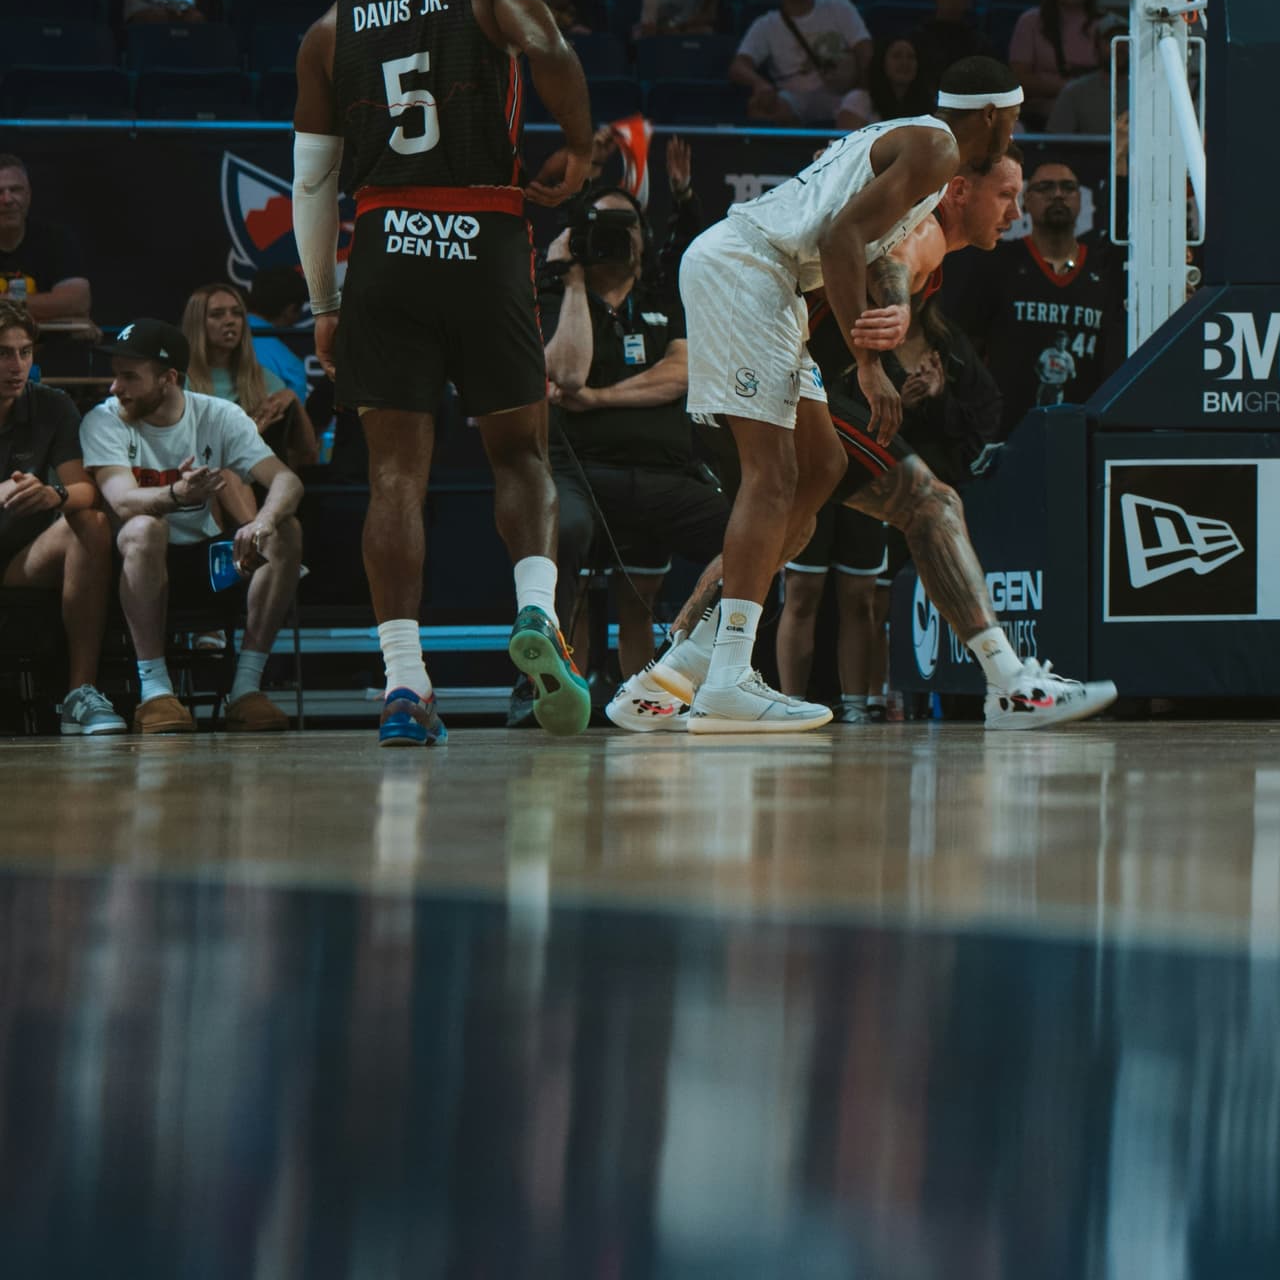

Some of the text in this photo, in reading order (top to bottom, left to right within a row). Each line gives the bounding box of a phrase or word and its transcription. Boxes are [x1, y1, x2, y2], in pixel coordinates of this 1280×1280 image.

[381, 51, 440, 156] 5
[384, 210, 480, 240] NOVO
[386, 235, 478, 261] DENTAL
[1013, 300, 1103, 329] TERRY FOX
